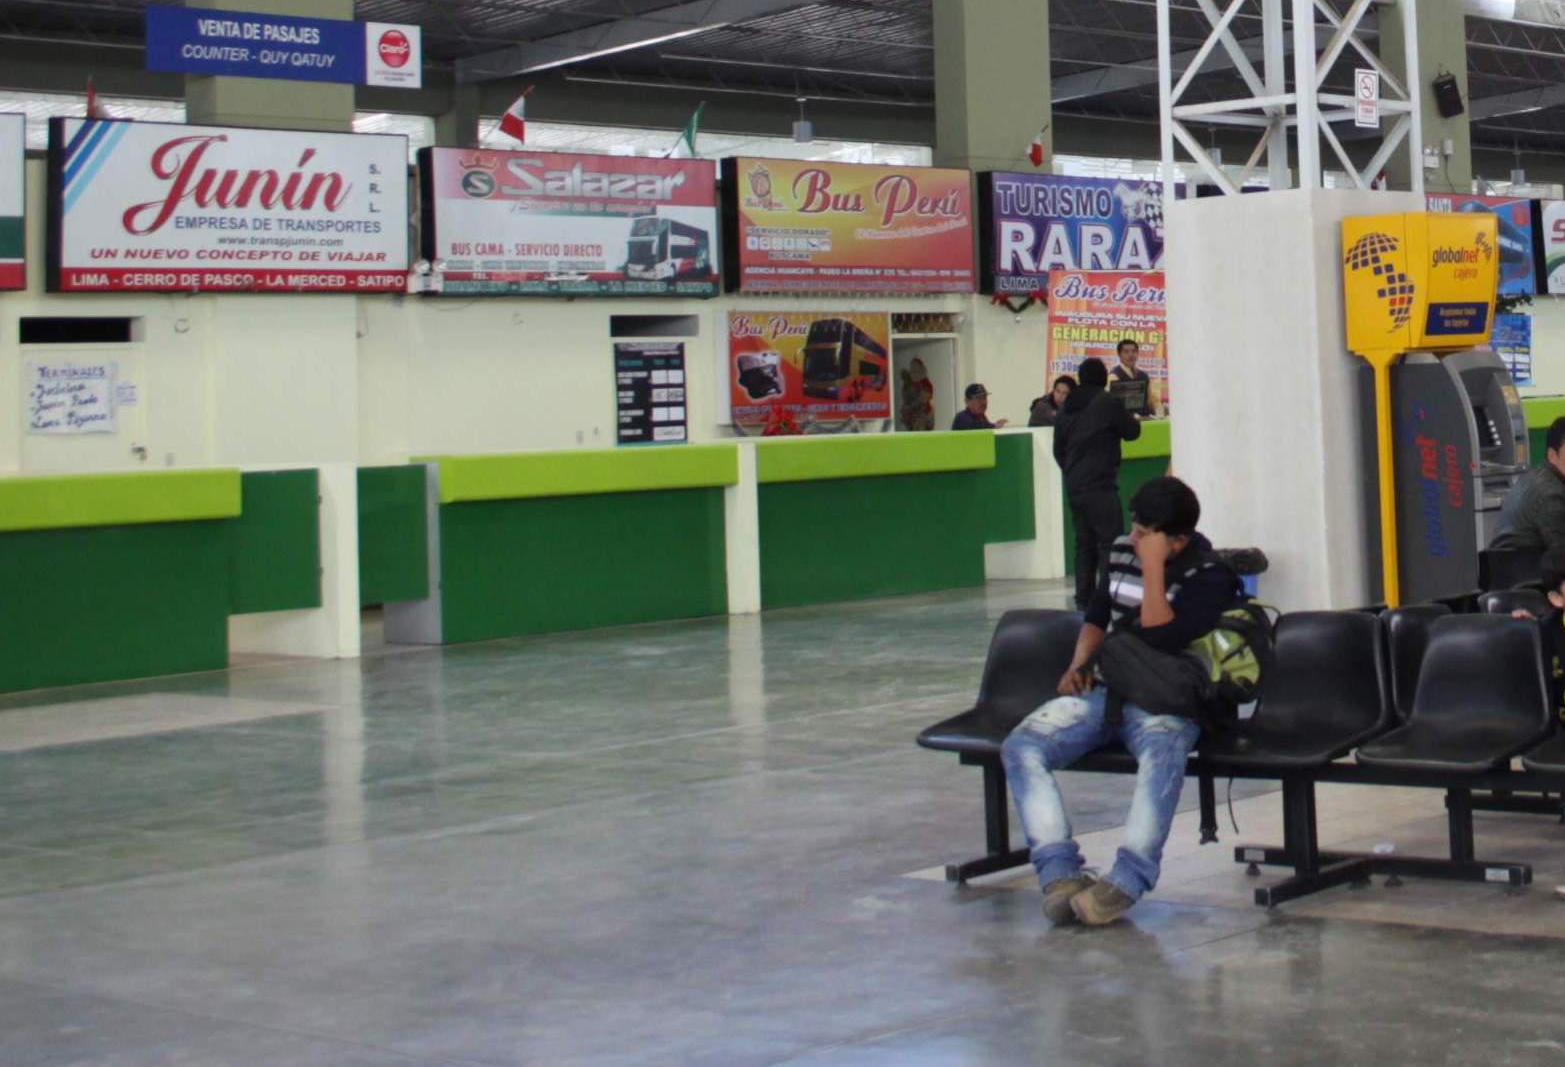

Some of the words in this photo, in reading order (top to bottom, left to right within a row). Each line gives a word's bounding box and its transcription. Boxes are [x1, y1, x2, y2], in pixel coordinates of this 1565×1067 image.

[197, 18, 241, 37] VENTA
[242, 22, 261, 40] DE
[263, 24, 321, 45] PASAJES
[181, 44, 250, 62] COUNTER
[259, 49, 289, 65] QUY
[123, 134, 353, 235] Junín
[500, 157, 687, 200] Salazar
[792, 168, 865, 213] Bus
[874, 174, 962, 228] Perú
[996, 181, 1114, 219] TURISMO
[175, 216, 248, 230] EMPRESA
[252, 218, 272, 230] DE
[277, 218, 382, 233] TRANSPORTES
[90, 248, 118, 259] UN
[124, 248, 189, 260] NUEVO
[195, 249, 293, 261] CONCEPTO
[298, 251, 321, 261] DE
[327, 252, 387, 262] VIAJAR
[451, 242, 471, 256] BUS
[474, 243, 504, 256] CAMA
[514, 243, 560, 257] SERVICIO
[563, 244, 603, 257] DIRECTO
[1432, 246, 1480, 268] globalnet
[71, 273, 110, 286] LIMA
[123, 273, 176, 286] CERRO
[180, 273, 201, 286] DE
[204, 274, 254, 287] PASCO
[266, 274, 283, 286] LA
[288, 275, 346, 286] MERCED
[357, 275, 405, 287] SATIPO
[1000, 276, 1040, 291] LIMA
[1053, 274, 1109, 300] Bus
[731, 315, 763, 335] Bus
[1067, 317, 1109, 326] FLOTA
[1110, 318, 1138, 327] CON
[1139, 320, 1156, 328] LA
[1052, 324, 1145, 344] GENERACIÓN
